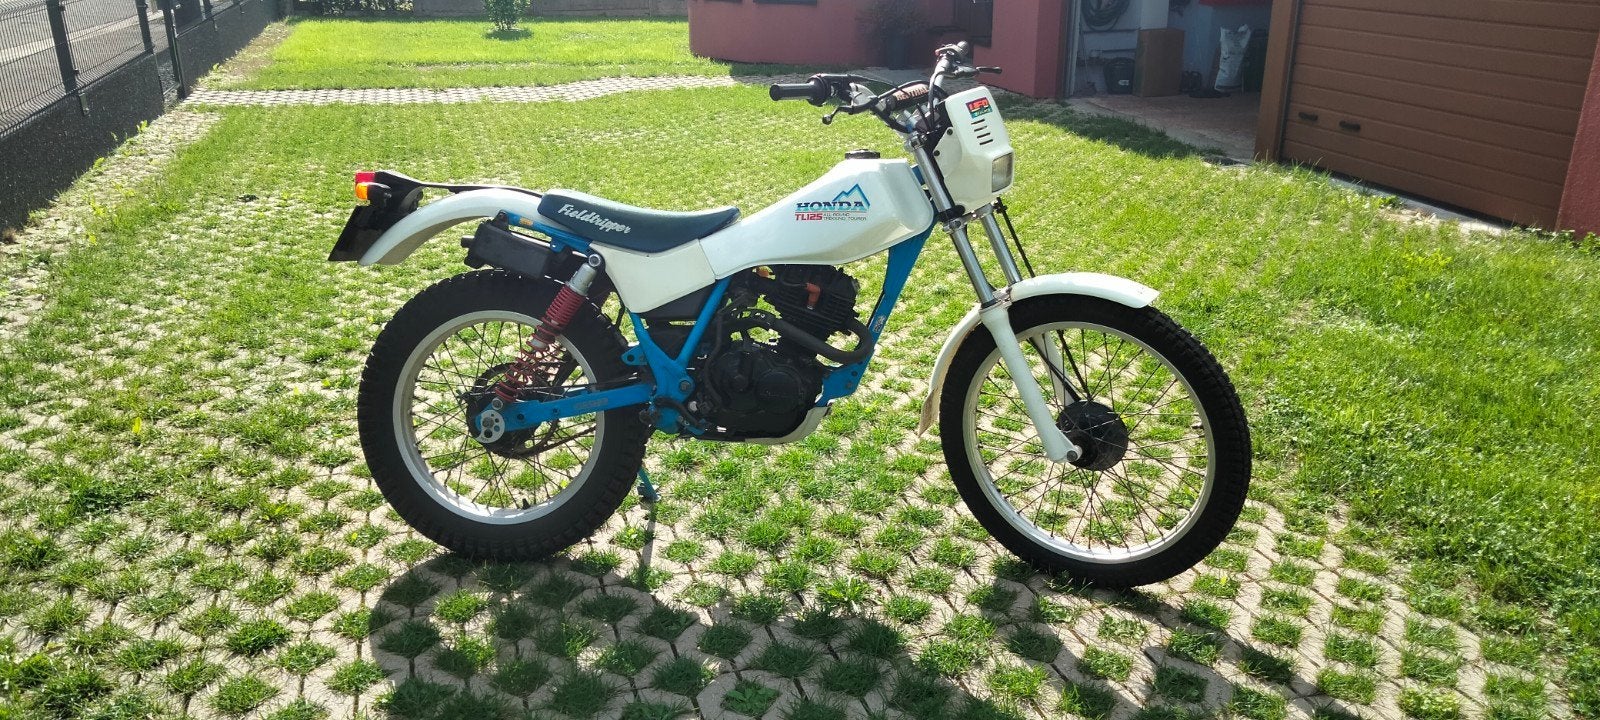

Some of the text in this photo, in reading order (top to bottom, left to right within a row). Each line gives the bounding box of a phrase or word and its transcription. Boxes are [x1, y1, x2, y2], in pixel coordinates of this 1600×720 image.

[795, 201, 867, 212] HONDA
[557, 203, 631, 234] Fieldtripper
[795, 212, 823, 221] TL125
